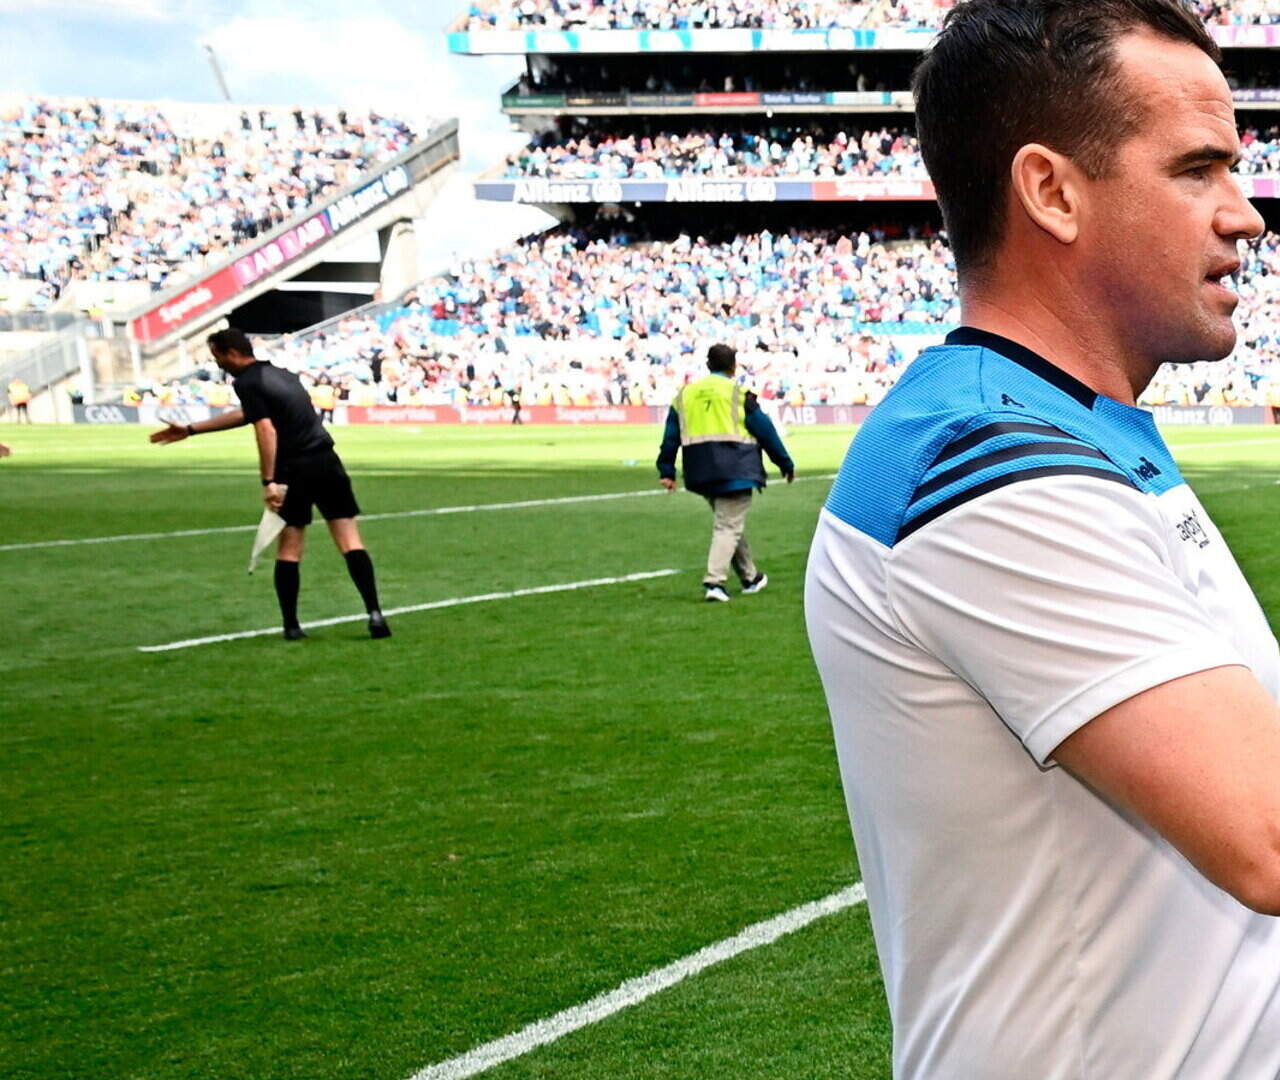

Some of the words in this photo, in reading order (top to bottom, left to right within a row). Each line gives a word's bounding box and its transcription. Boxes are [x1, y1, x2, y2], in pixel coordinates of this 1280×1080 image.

[513, 183, 589, 203] Allianz
[666, 182, 743, 202] Allianz
[326, 180, 388, 231] Allianz
[297, 217, 326, 249] AIB
[253, 243, 286, 278] AIB
[780, 406, 816, 424] AIB
